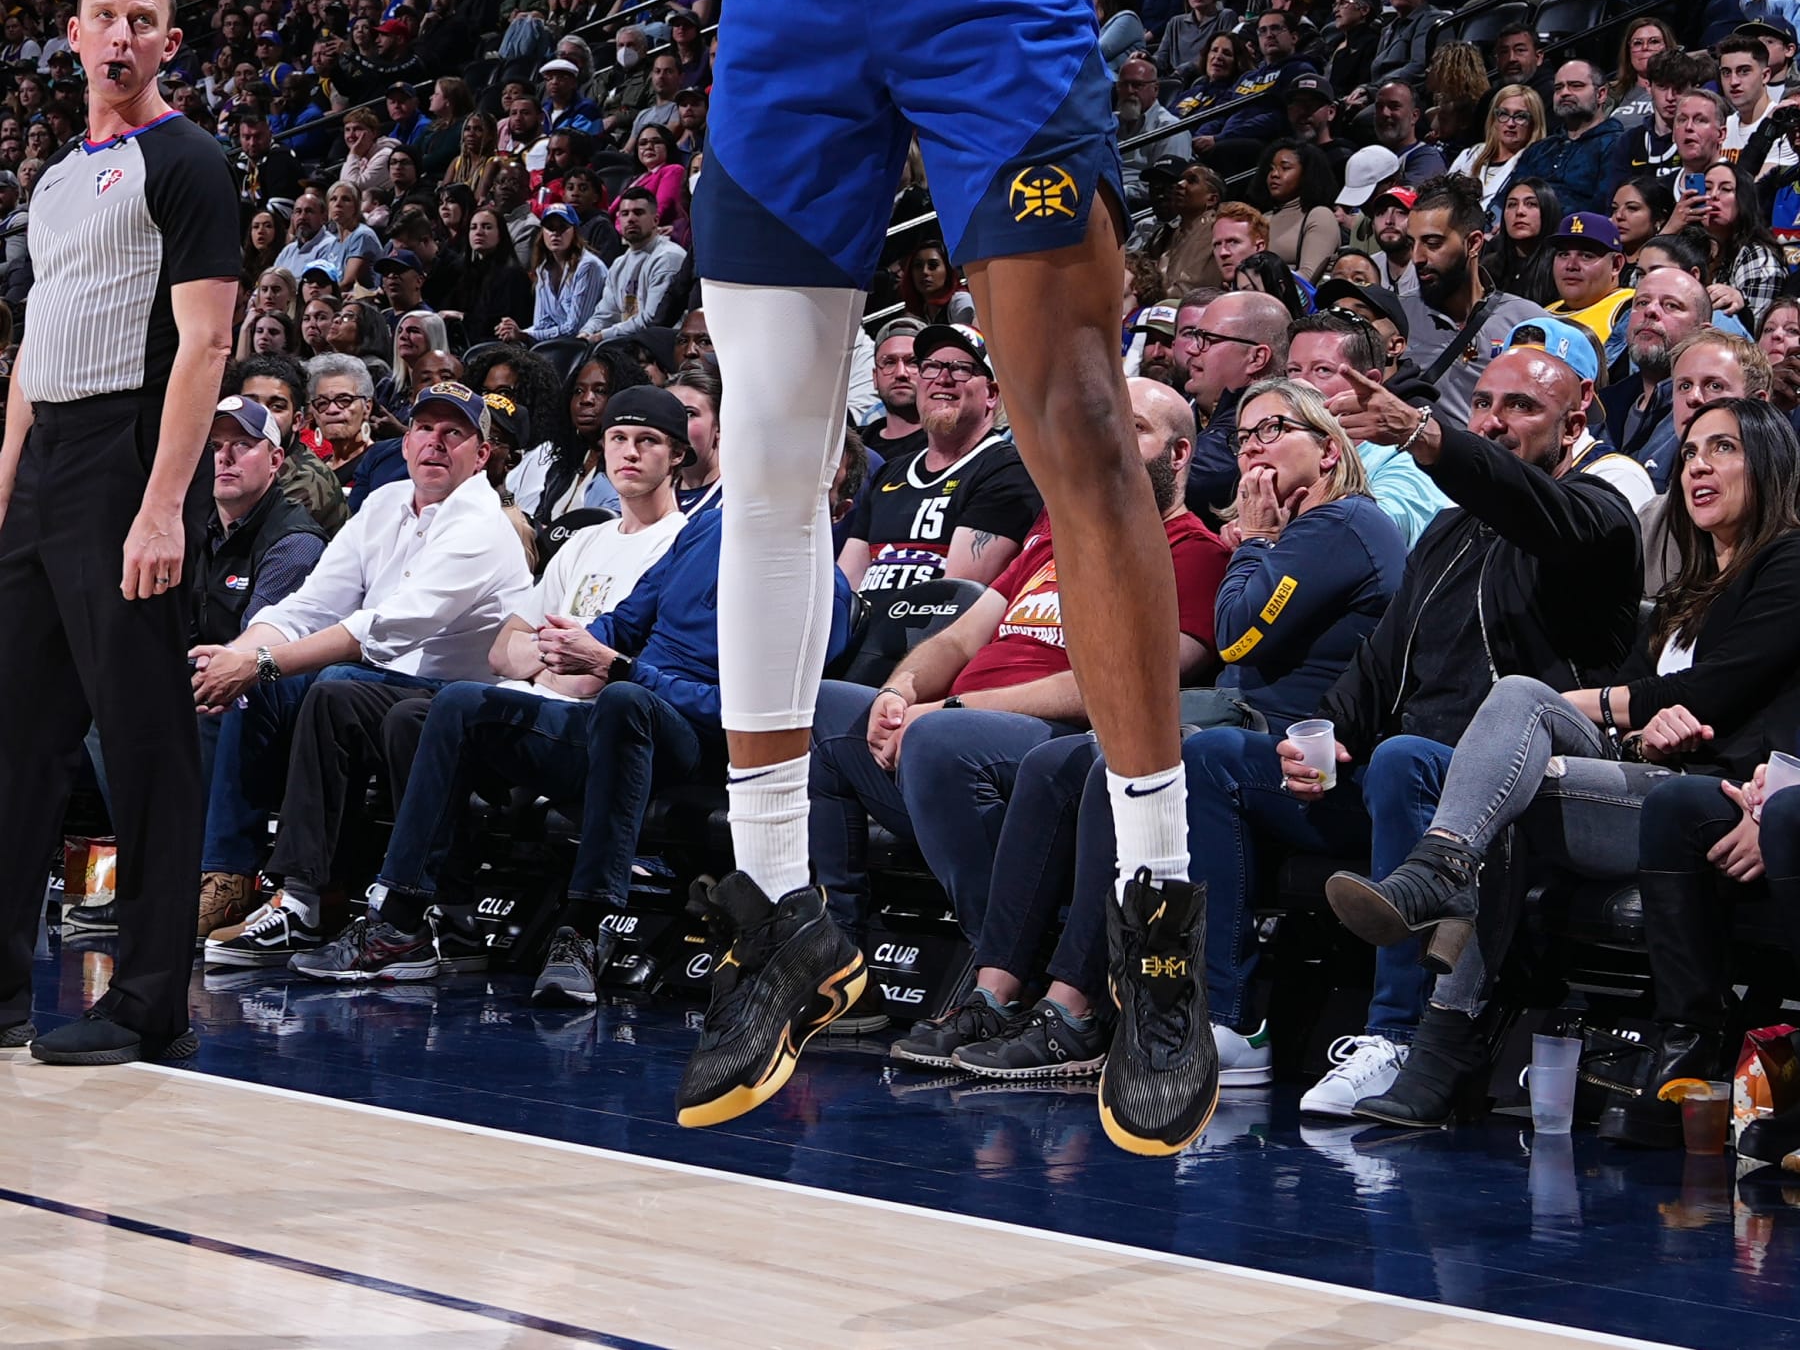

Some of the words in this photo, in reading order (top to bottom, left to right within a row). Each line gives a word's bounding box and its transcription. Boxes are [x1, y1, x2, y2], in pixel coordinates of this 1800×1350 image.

[1570, 216, 1585, 234] LA
[910, 496, 951, 539] 15
[857, 563, 935, 592] GGETS
[909, 604, 959, 615] LEXUS
[1265, 582, 1292, 617] DENVER
[1229, 634, 1253, 657] 5280
[477, 897, 515, 916] CLUB
[599, 914, 639, 933] CLUB
[874, 942, 920, 965] CLUB
[879, 983, 927, 1004] XUS
